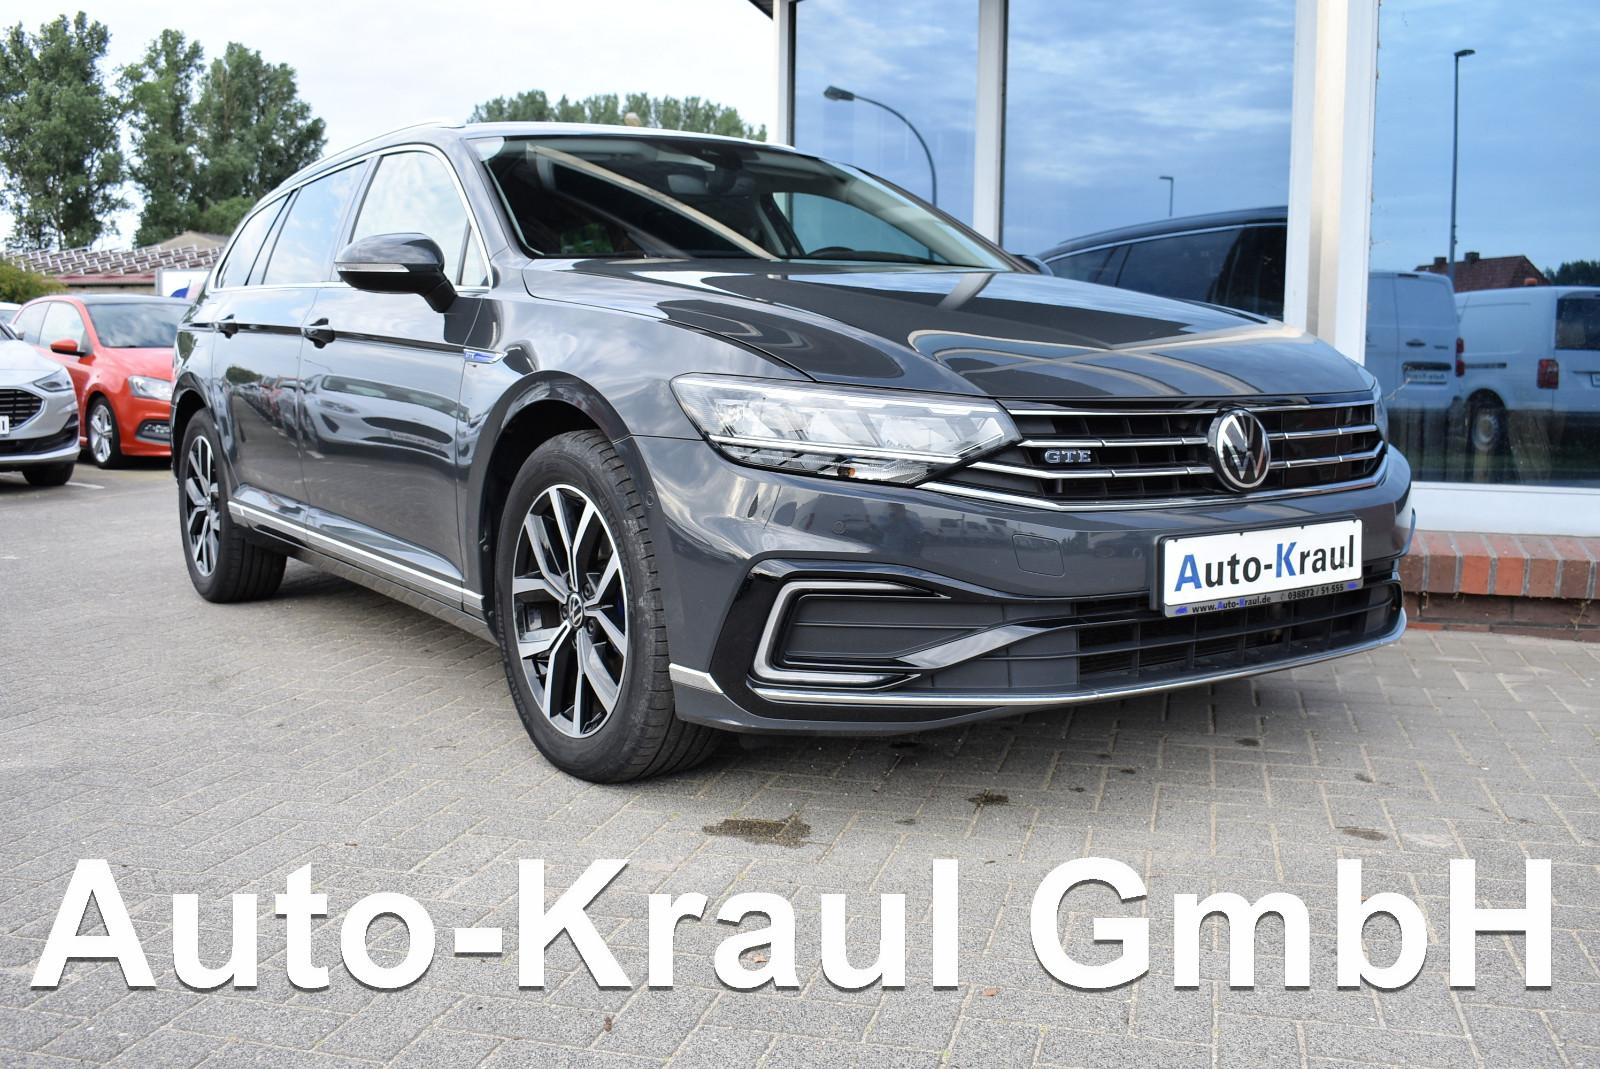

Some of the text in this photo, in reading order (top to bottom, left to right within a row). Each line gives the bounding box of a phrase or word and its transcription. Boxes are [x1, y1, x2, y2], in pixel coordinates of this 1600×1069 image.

[1045, 450, 1091, 463] GTE
[1174, 535, 1354, 592] Auto-Kraul
[1192, 594, 1271, 613] www.Auto-Kraul.de
[1331, 583, 1344, 593] 555
